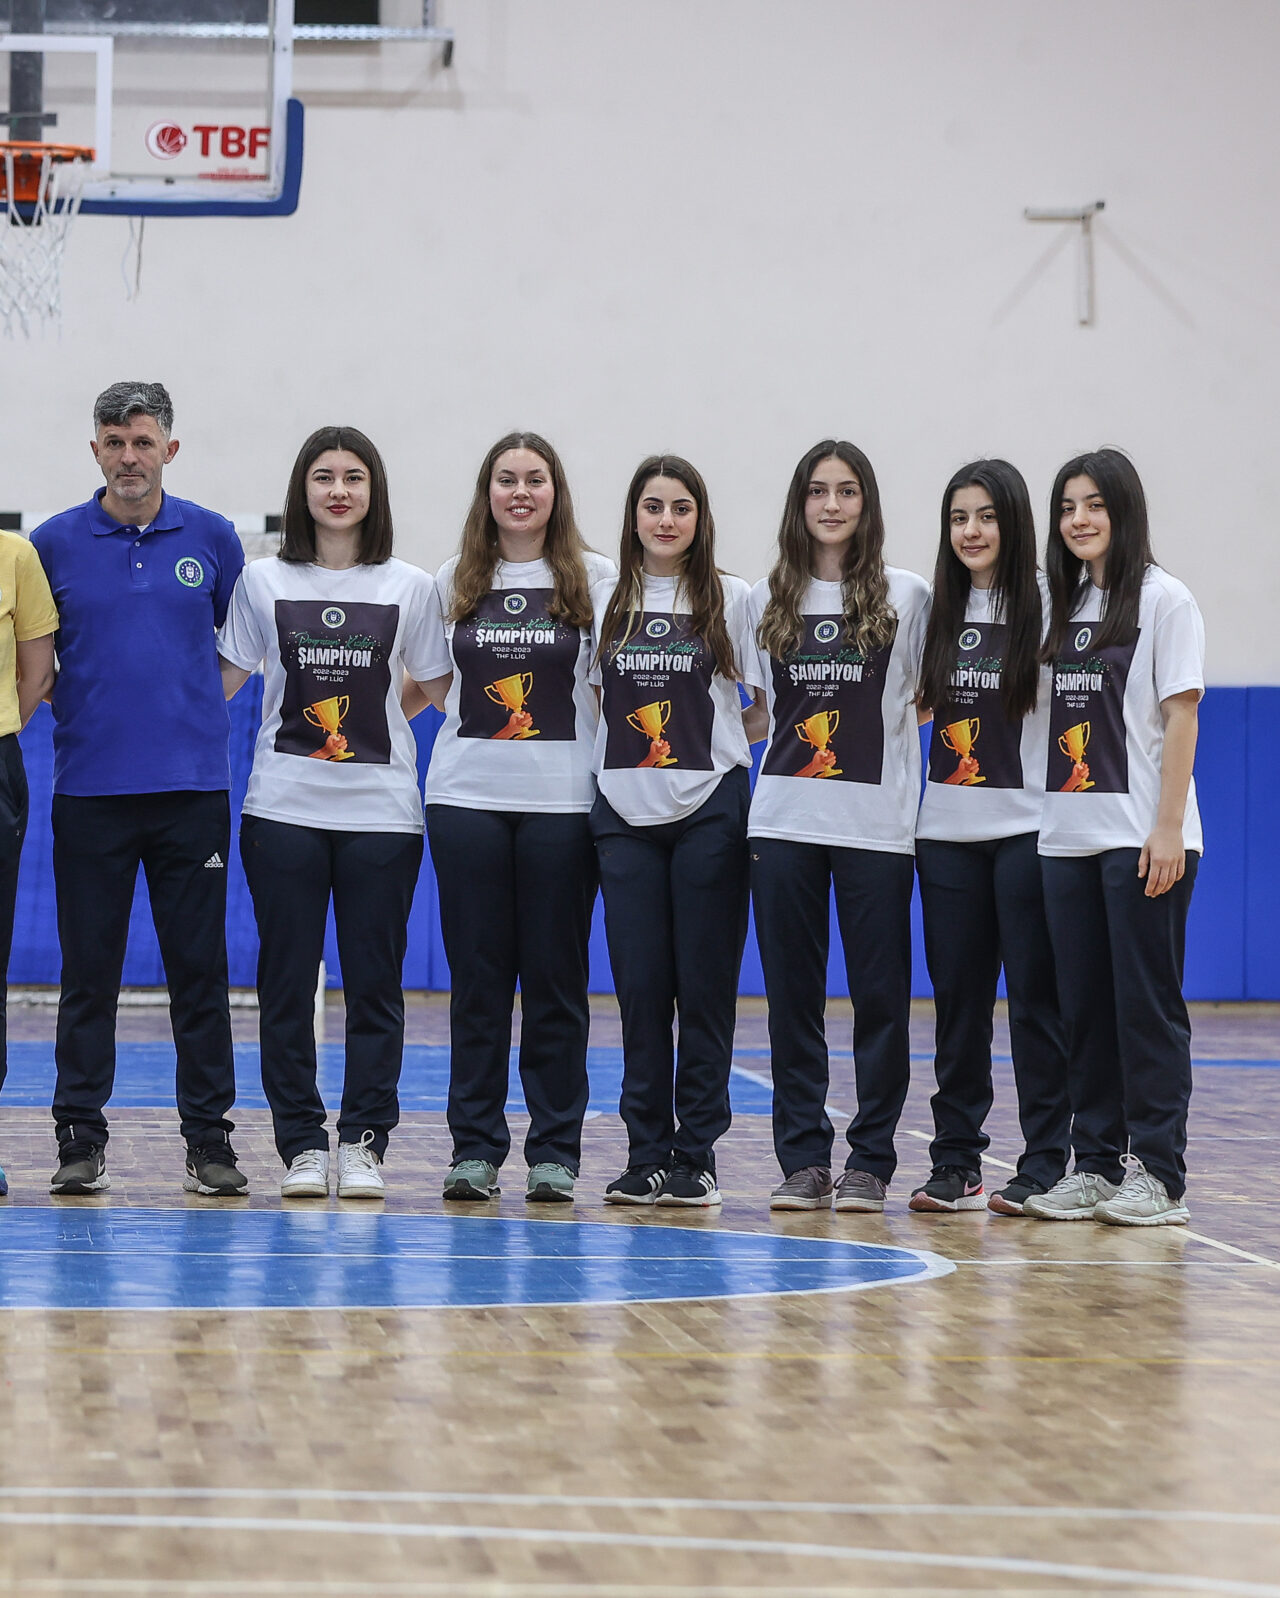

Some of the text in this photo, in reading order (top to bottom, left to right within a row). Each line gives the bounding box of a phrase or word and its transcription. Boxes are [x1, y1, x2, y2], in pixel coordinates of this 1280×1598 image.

[192, 125, 272, 159] TBF
[475, 627, 555, 648] ŞAMPİYON
[298, 645, 372, 670] ŞAMPİYON
[616, 651, 693, 676] ŞAMPİYON
[312, 668, 349, 676] 2022-2023
[788, 660, 864, 686] ŞAMPİYON
[1055, 669, 1103, 697] ŞAMPİYON
